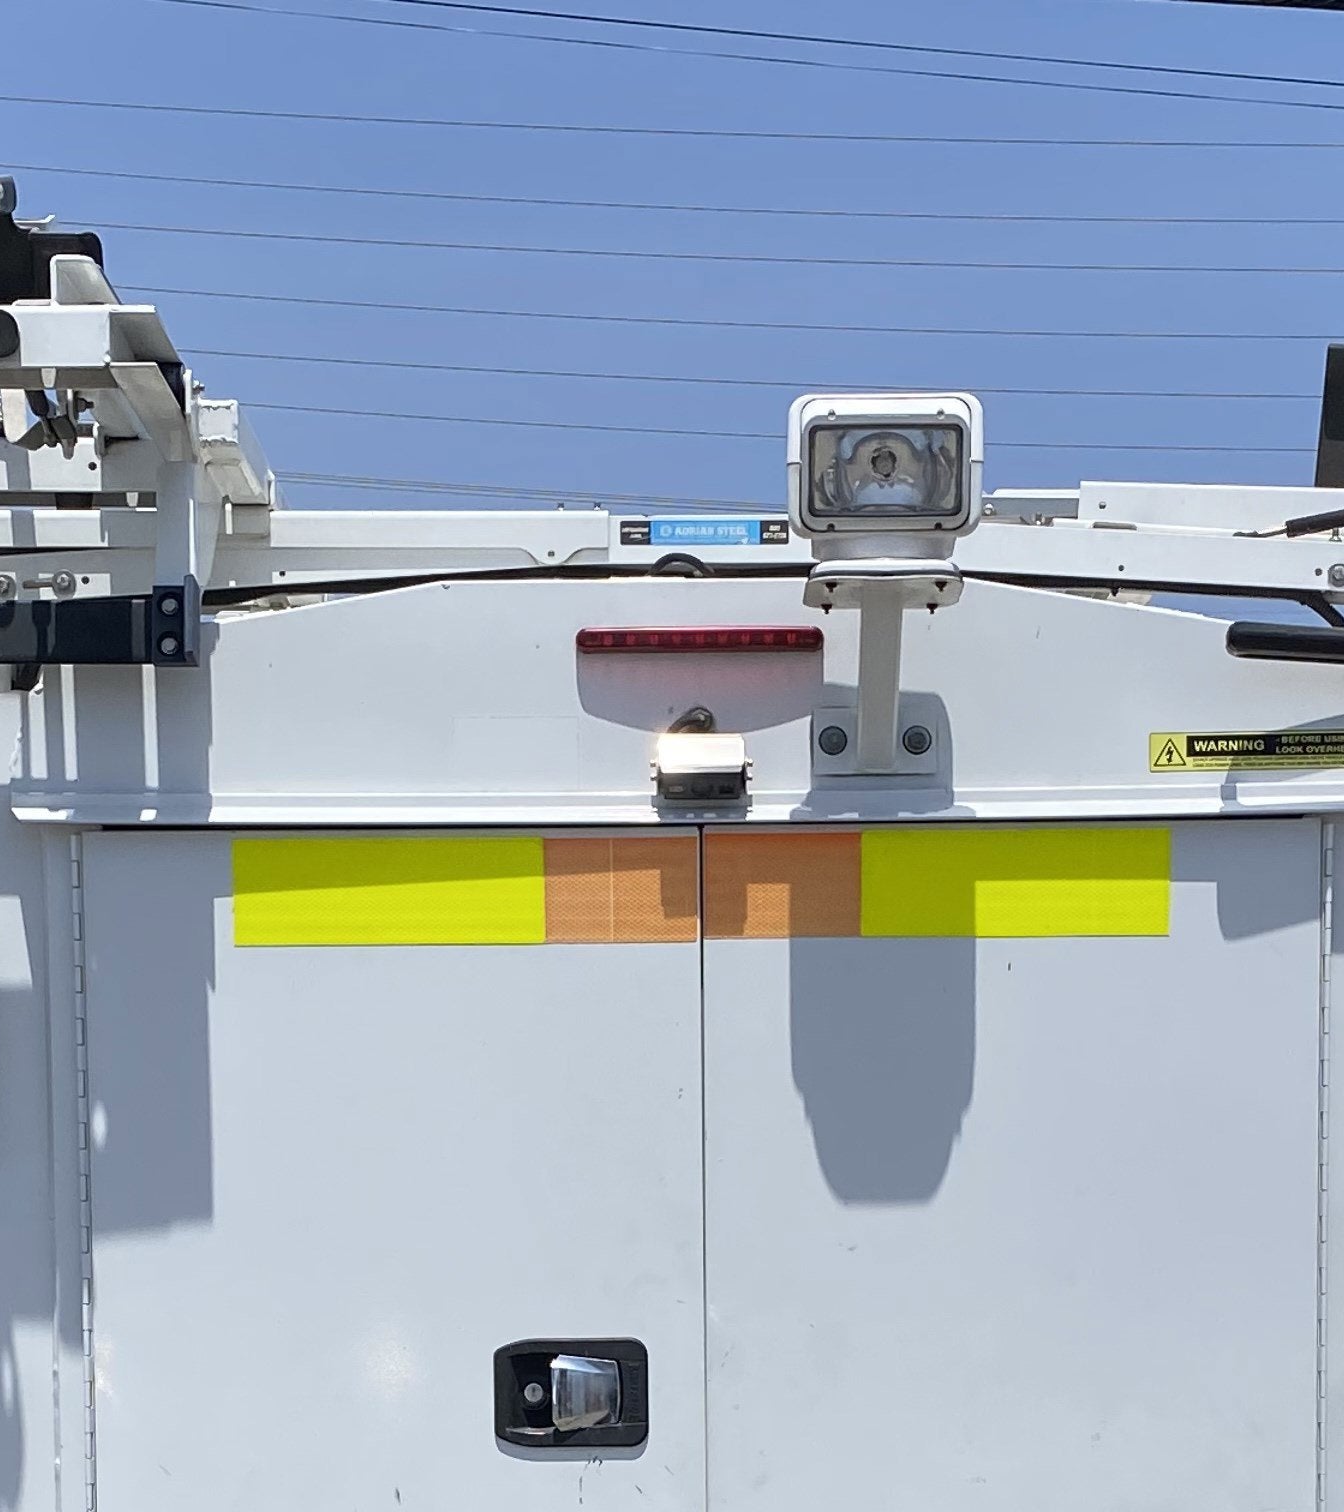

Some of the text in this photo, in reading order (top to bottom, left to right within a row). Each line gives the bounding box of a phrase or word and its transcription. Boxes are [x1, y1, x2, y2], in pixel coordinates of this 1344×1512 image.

[674, 525, 715, 537] ADRIAN
[716, 525, 748, 537] STEEL
[1281, 735, 1321, 744] BEFORE
[1193, 739, 1265, 752] WARNING
[1275, 745, 1304, 754] LOOK
